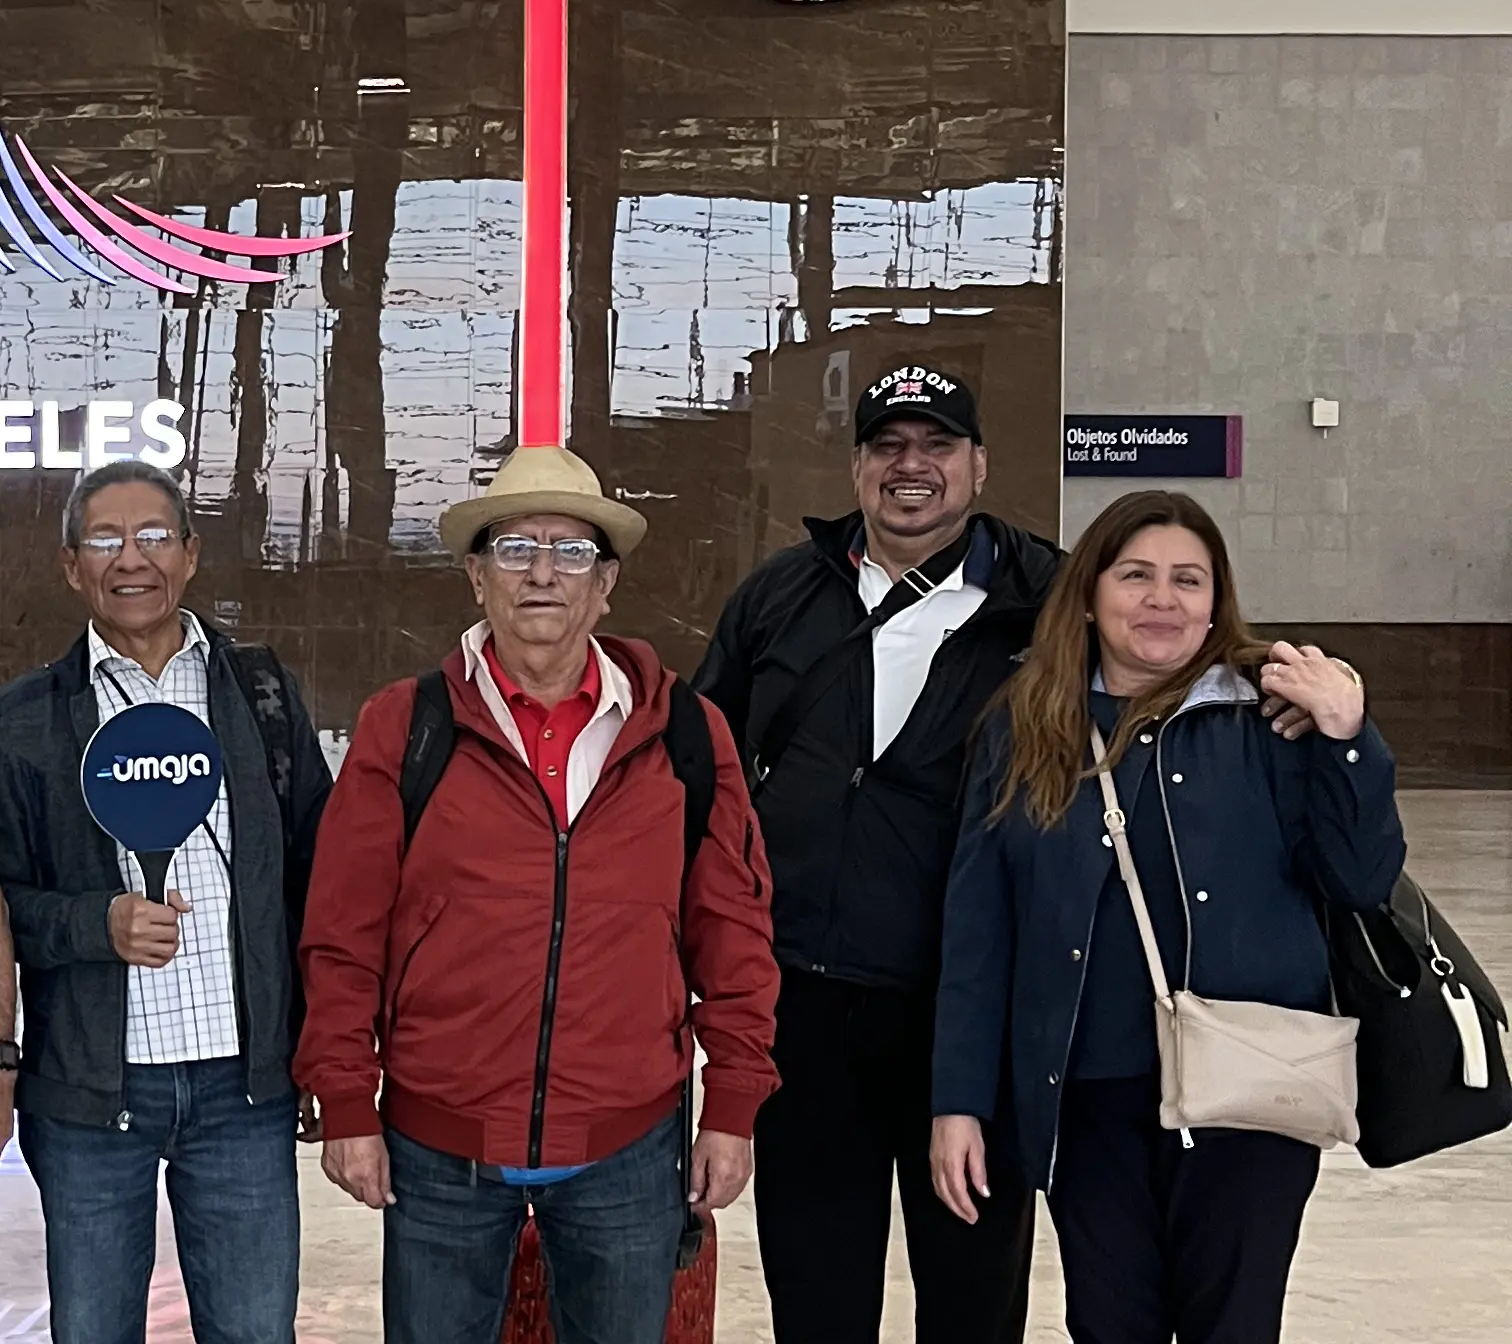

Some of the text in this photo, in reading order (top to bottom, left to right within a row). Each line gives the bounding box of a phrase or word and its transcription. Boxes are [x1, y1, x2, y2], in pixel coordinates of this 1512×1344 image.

[867, 365, 958, 400] LONDON
[1066, 427, 1189, 448] Objetos Olvidados
[1067, 447, 1137, 462] Lost & Found
